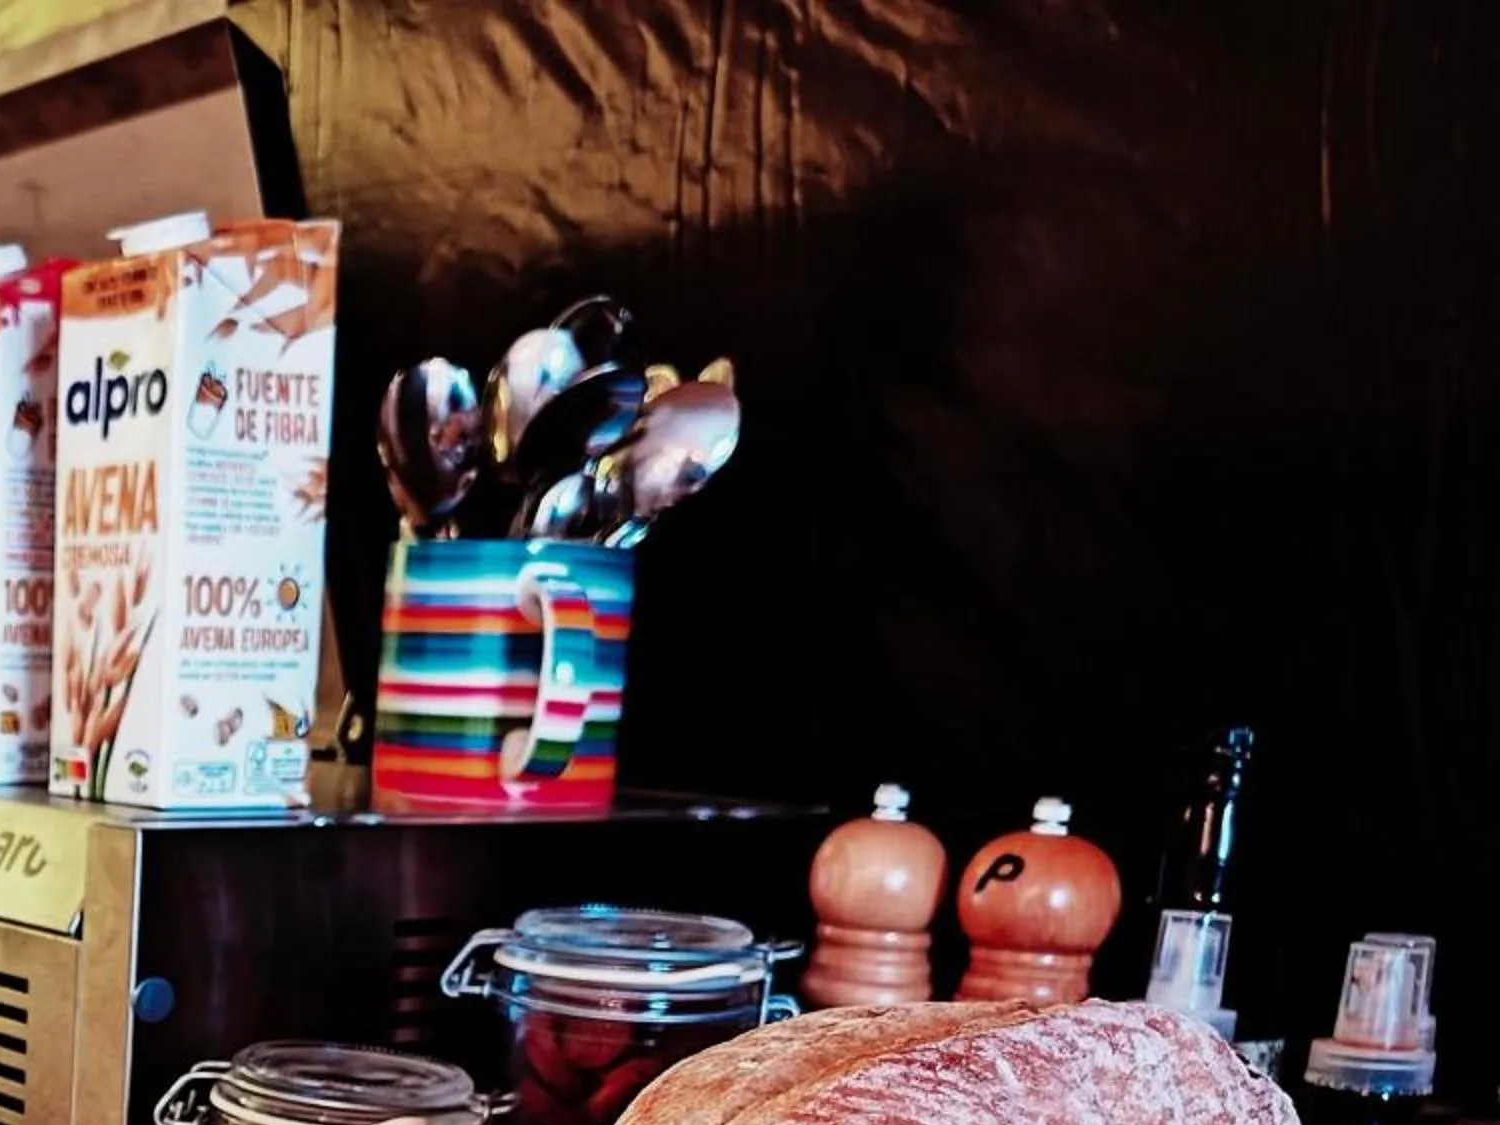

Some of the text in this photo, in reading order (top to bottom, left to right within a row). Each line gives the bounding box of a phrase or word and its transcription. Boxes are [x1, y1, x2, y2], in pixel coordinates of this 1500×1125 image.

[65, 356, 167, 439] alpro
[236, 368, 320, 406] FUENTE
[235, 408, 319, 446] DE FIBRA
[64, 461, 158, 536] AVENA
[5, 578, 52, 618] 100
[184, 574, 261, 620] 100%
[180, 625, 235, 652] AVENA
[974, 852, 1026, 893] P
